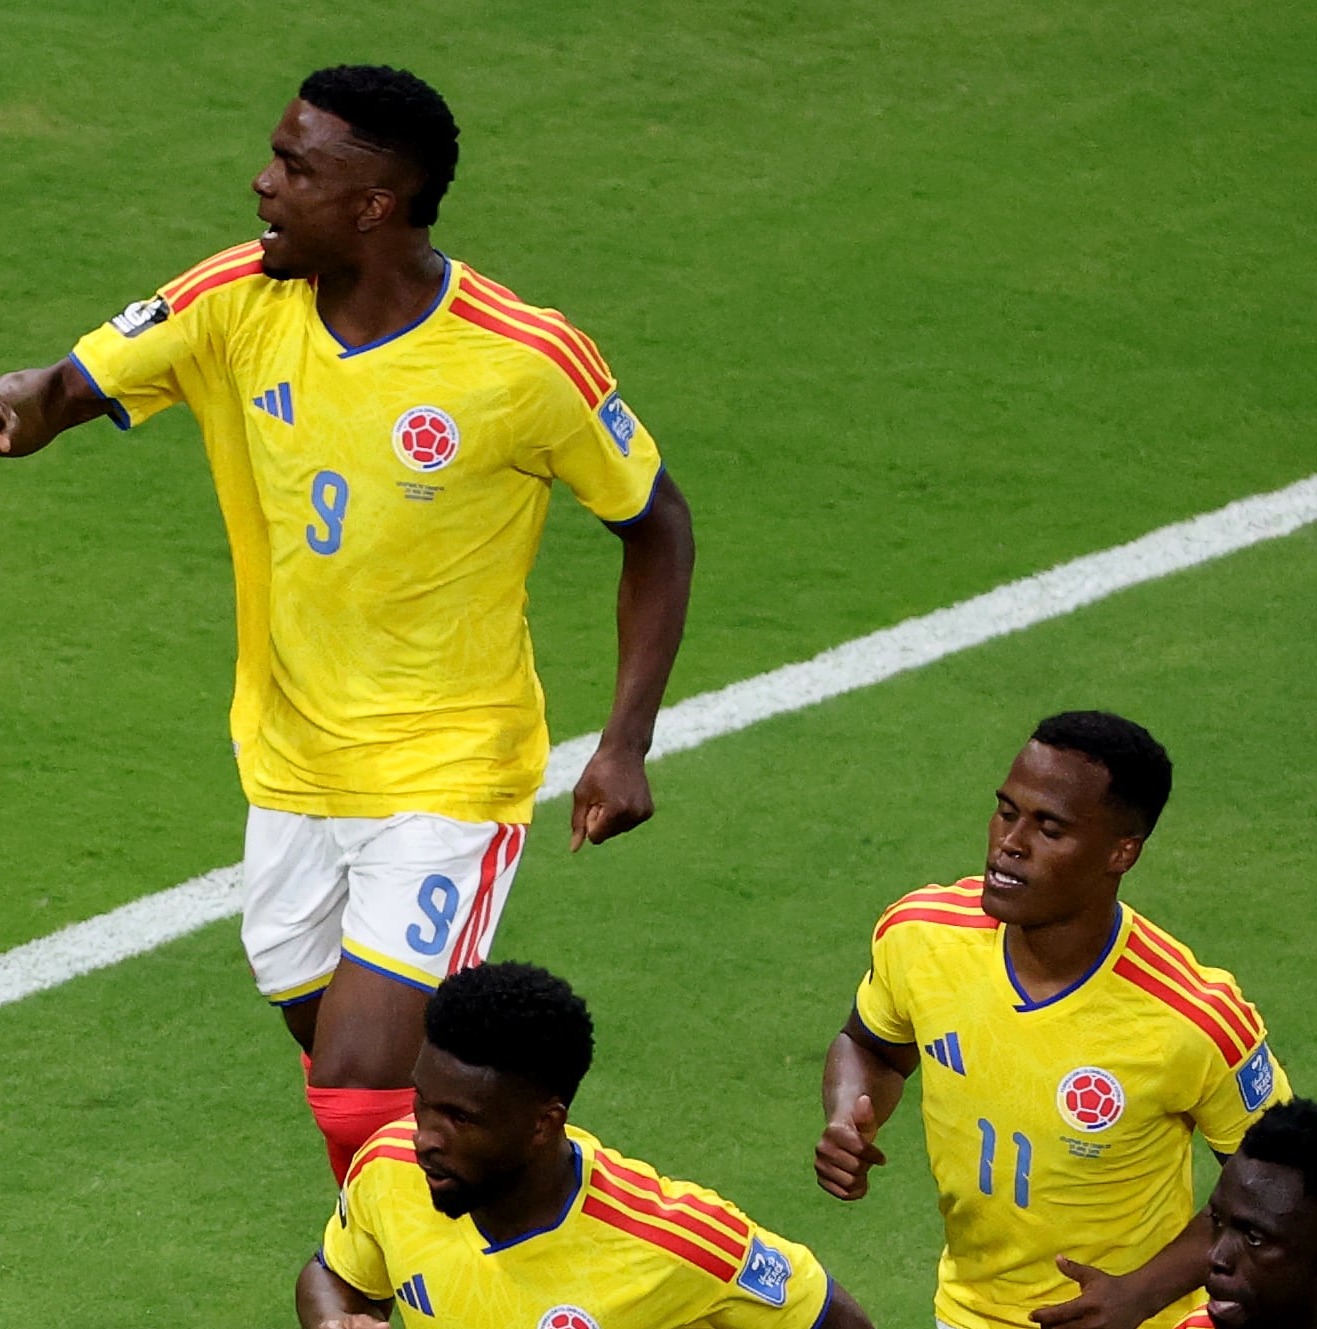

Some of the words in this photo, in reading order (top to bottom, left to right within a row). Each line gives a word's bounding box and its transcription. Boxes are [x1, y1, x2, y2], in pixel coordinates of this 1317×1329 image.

[305, 470, 349, 556] 9
[406, 873, 461, 957] 9
[977, 1118, 1032, 1208] 11
